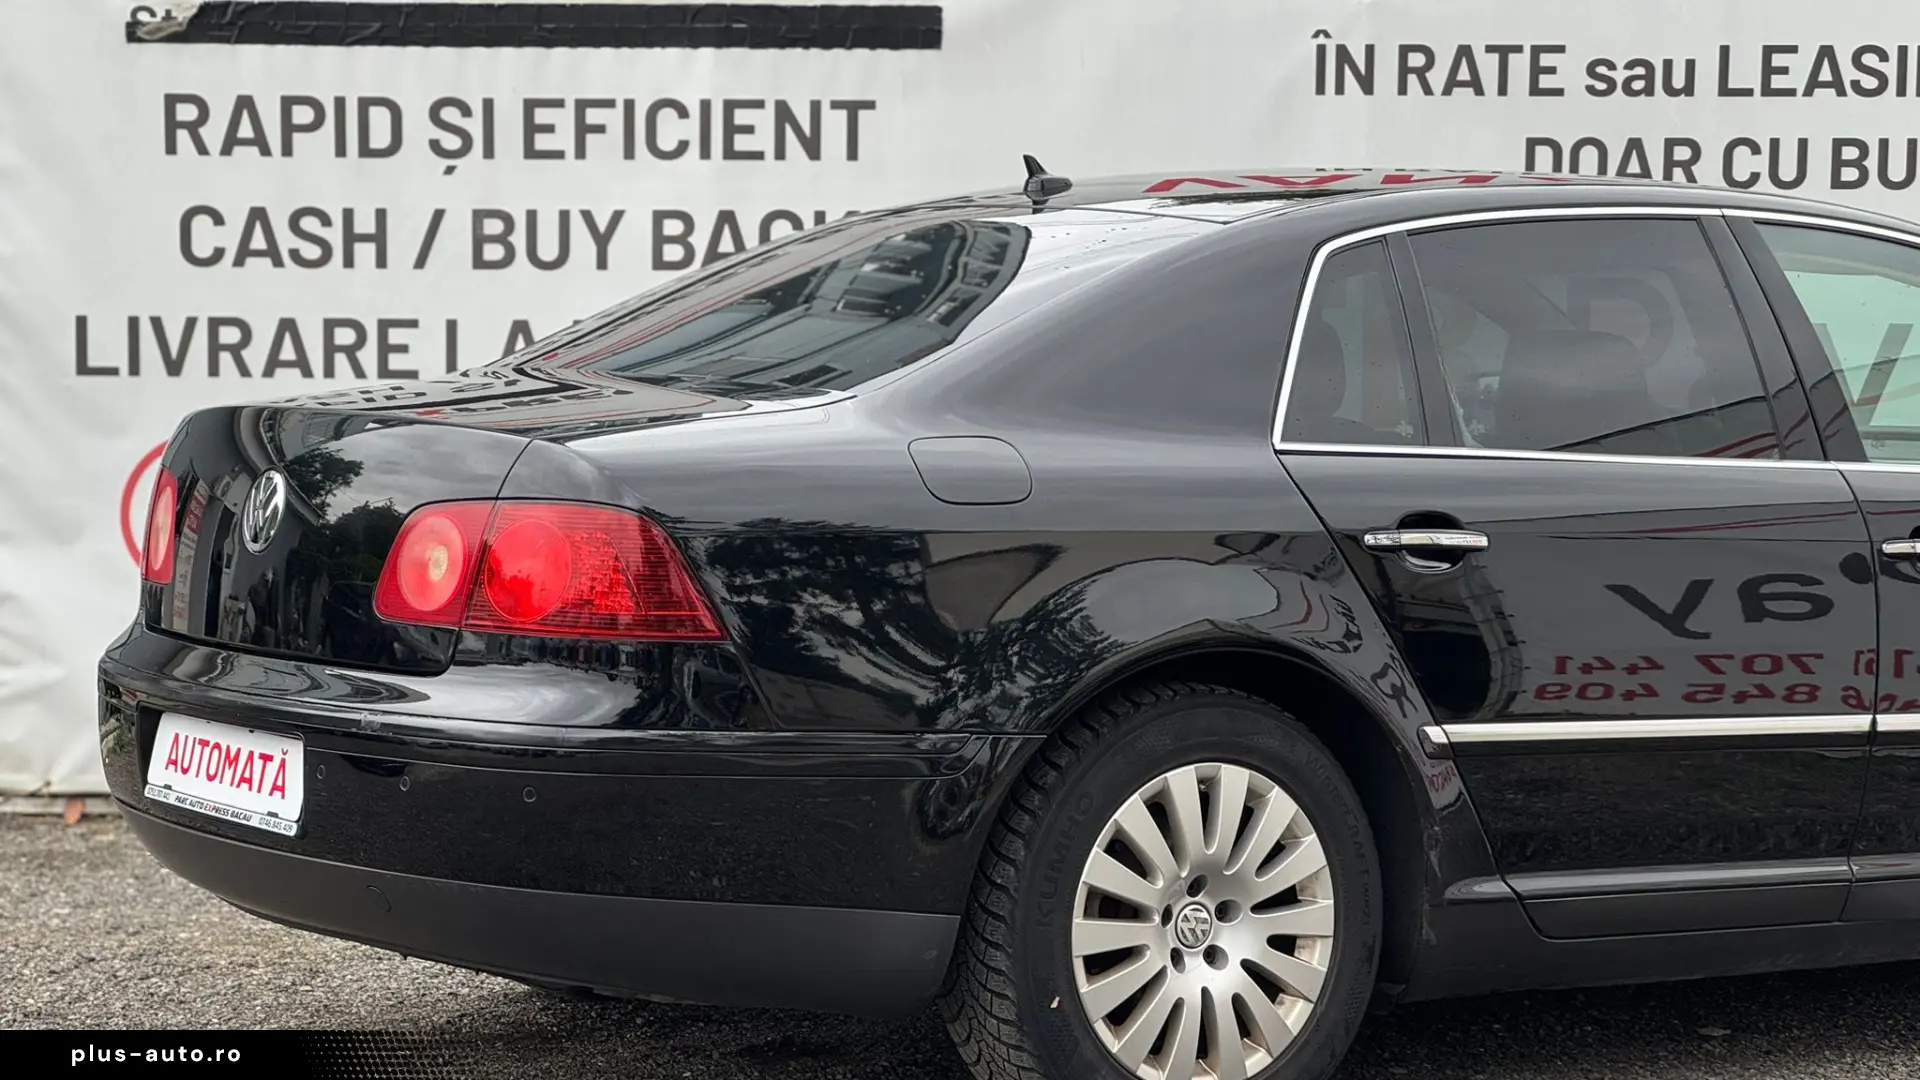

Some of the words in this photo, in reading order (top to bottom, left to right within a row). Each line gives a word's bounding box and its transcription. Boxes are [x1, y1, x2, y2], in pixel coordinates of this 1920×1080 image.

[1311, 30, 1376, 96] ÎN
[1397, 44, 1567, 97] RATE
[1584, 57, 1696, 98] sau
[1717, 44, 1920, 98] LEASI
[163, 93, 403, 159] RAPID
[428, 96, 495, 176] ȘI
[522, 97, 877, 162] EFICIENT
[1524, 136, 1702, 184] DOAR
[1721, 136, 1809, 190] CU
[179, 204, 388, 270] CASH
[412, 208, 446, 270] /
[471, 208, 626, 271] BUY
[652, 209, 861, 271] BAC
[75, 315, 420, 380] LIVRARE
[165, 733, 288, 799] AUTOMATĂ
